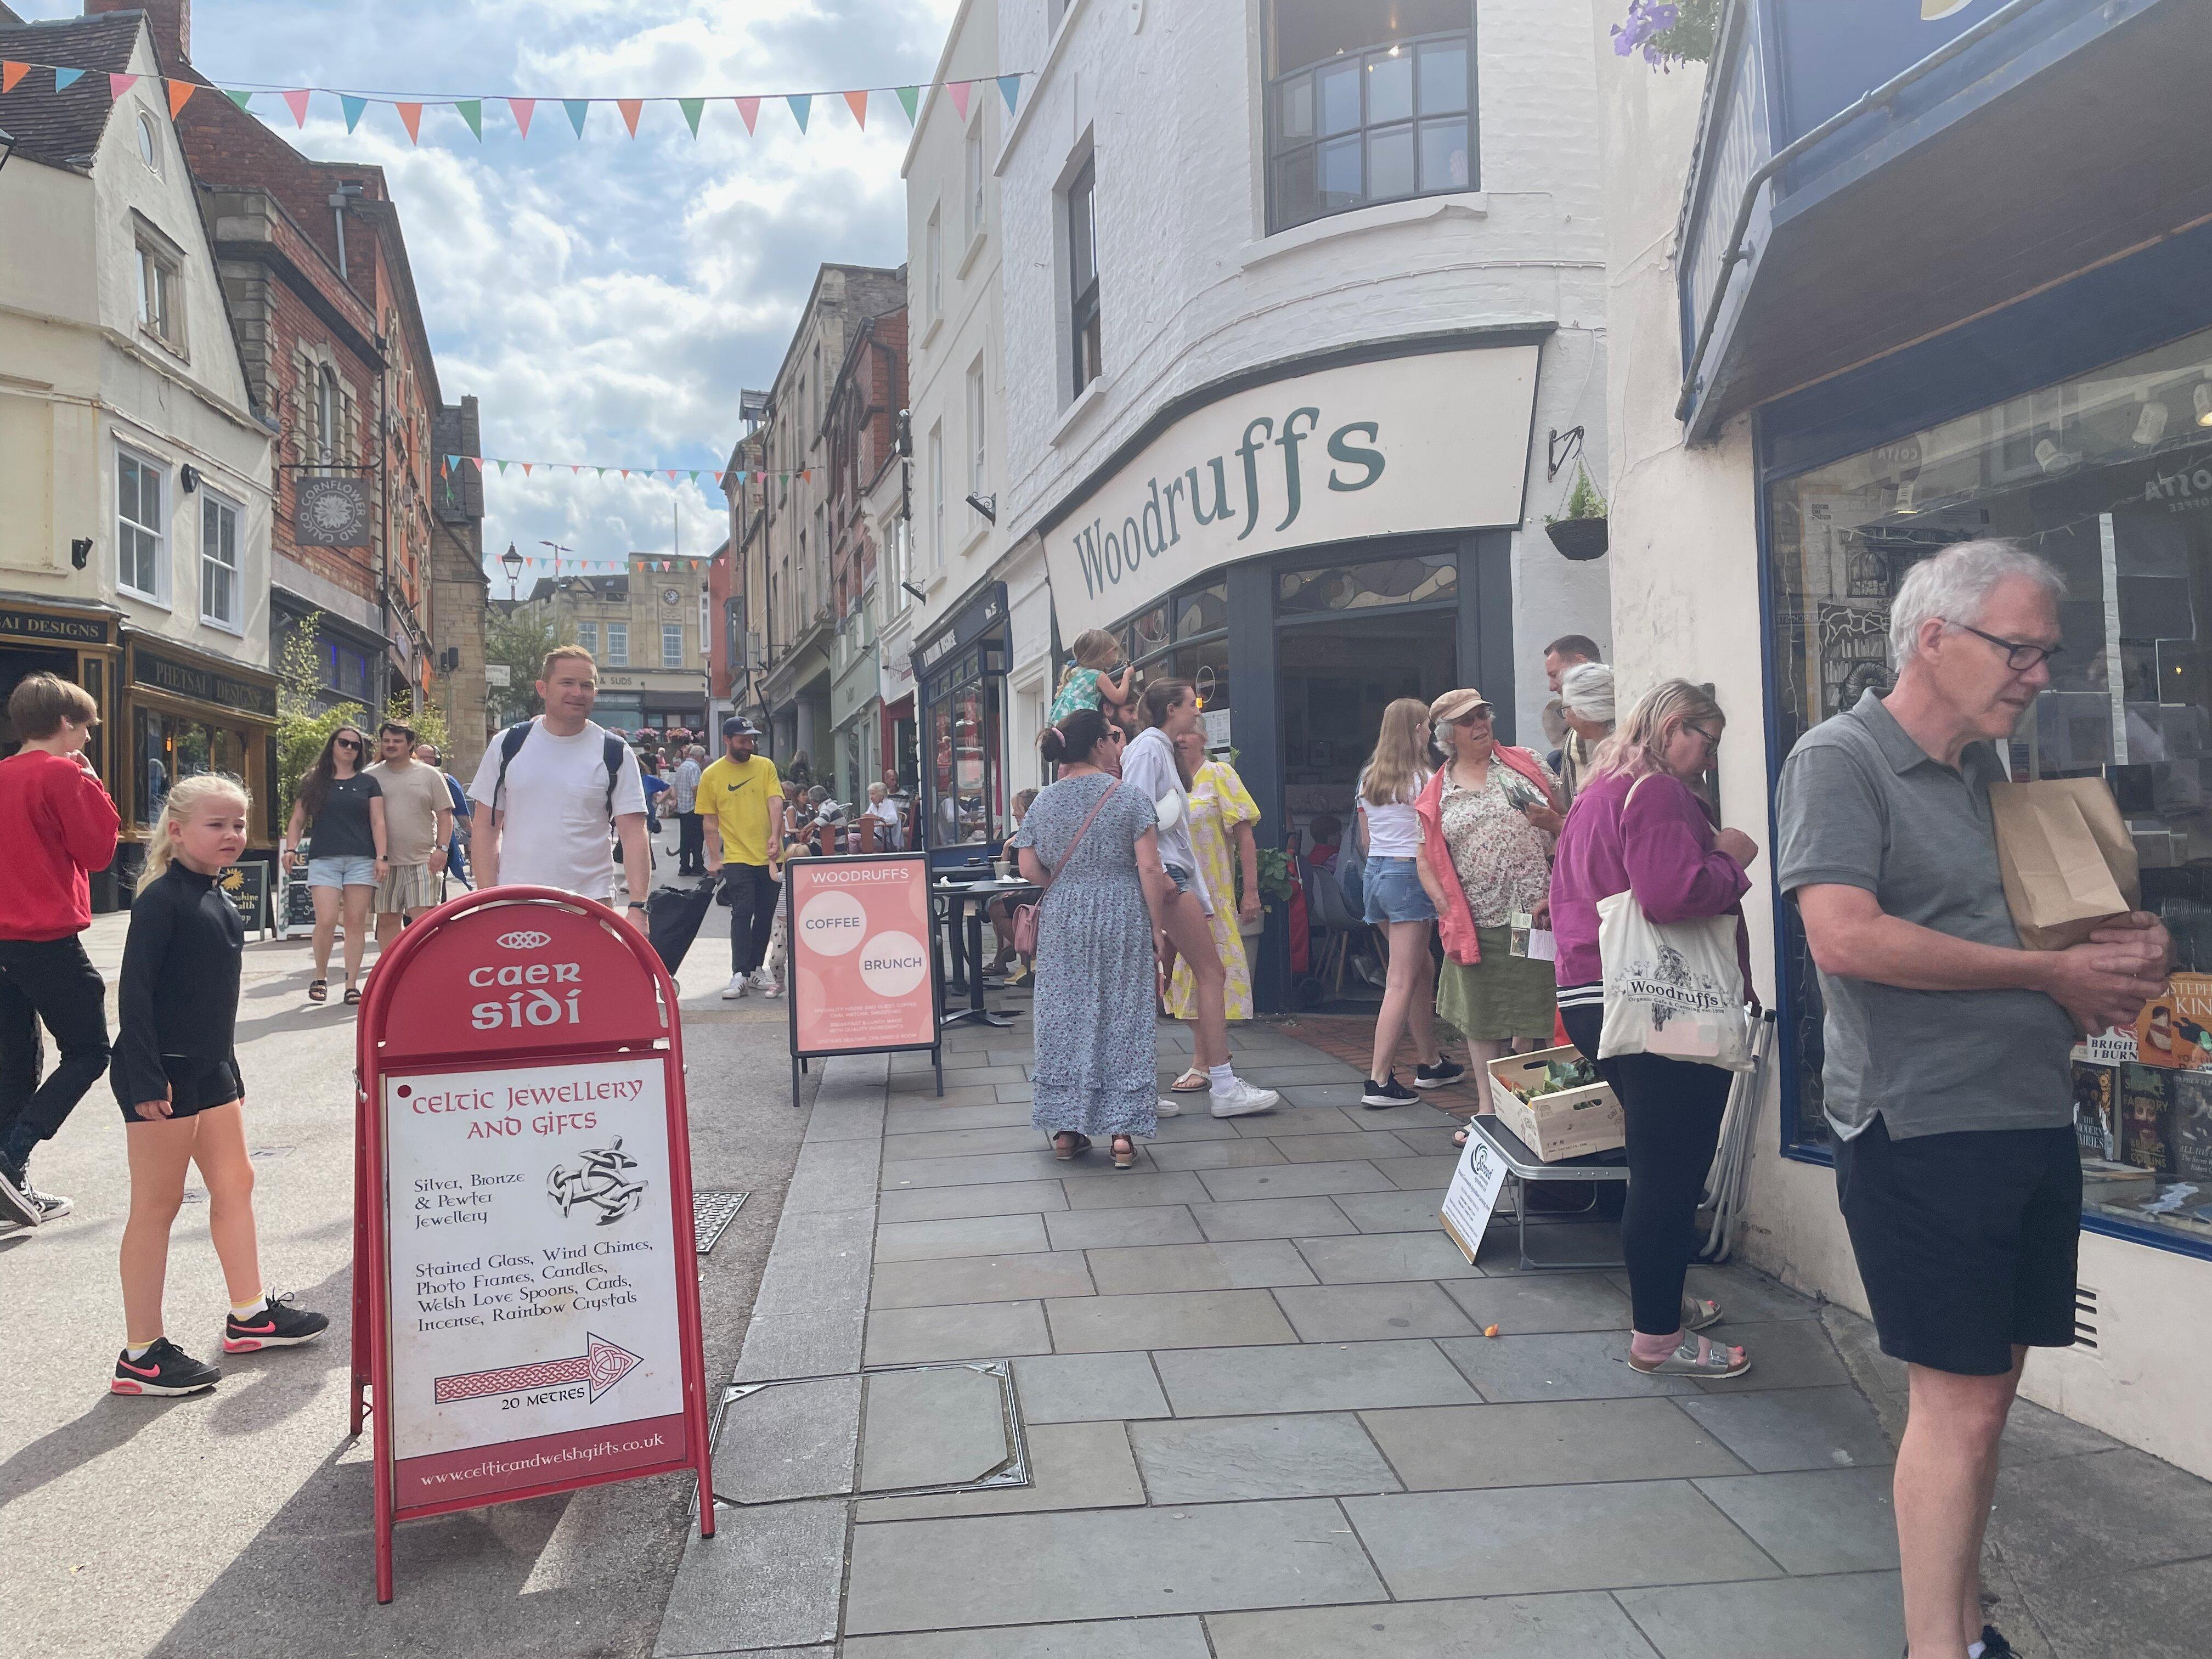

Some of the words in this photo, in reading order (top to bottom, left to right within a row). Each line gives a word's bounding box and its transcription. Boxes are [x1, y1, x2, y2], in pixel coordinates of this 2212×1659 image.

[302, 480, 365, 516] CORNFLOWER
[1073, 407, 1386, 600] Woodruffs
[300, 512, 334, 543] CALICO
[340, 520, 362, 540] AND
[0, 617, 20, 629] AI
[27, 618, 99, 637] DESIGNS
[156, 662, 206, 694] PHETSAI
[611, 677, 632, 685] SUDS
[811, 868, 909, 883] WOODRUFFS
[806, 917, 860, 929] COFFEE
[864, 957, 922, 970] BRUNCH
[1631, 981, 1718, 1008] Woodruffs
[1674, 1003, 1700, 1013] Catering
[2175, 997, 2212, 1015] KIN
[2094, 1049, 2098, 1058] I
[2102, 1050, 2137, 1060] BURN
[466, 1116, 521, 1139] AND
[414, 1179, 462, 1193] Silver,
[470, 1172, 525, 1187] Bronze
[415, 1197, 429, 1210] &
[438, 1192, 493, 1207] Pewter
[415, 1210, 487, 1229] Jewellery
[415, 1257, 481, 1278] Stained
[488, 1254, 534, 1269] Glass,
[543, 1244, 587, 1261] Wind
[594, 1239, 653, 1255] Chimes,
[416, 1278, 466, 1295] Photo
[473, 1272, 534, 1288] Frames,
[541, 1262, 608, 1280] Candles,
[417, 1295, 465, 1313] Welsh
[473, 1290, 513, 1306] Love
[520, 1284, 578, 1302] Spoons,
[585, 1275, 632, 1291] Cards,
[417, 1316, 484, 1332] Incense,
[492, 1303, 565, 1322] Rainbow
[573, 1291, 637, 1311] Crystals
[501, 1398, 520, 1410] 20
[526, 1387, 585, 1407] METRES
[420, 1432, 665, 1486] www.celticandwelshgifts.co.uk
